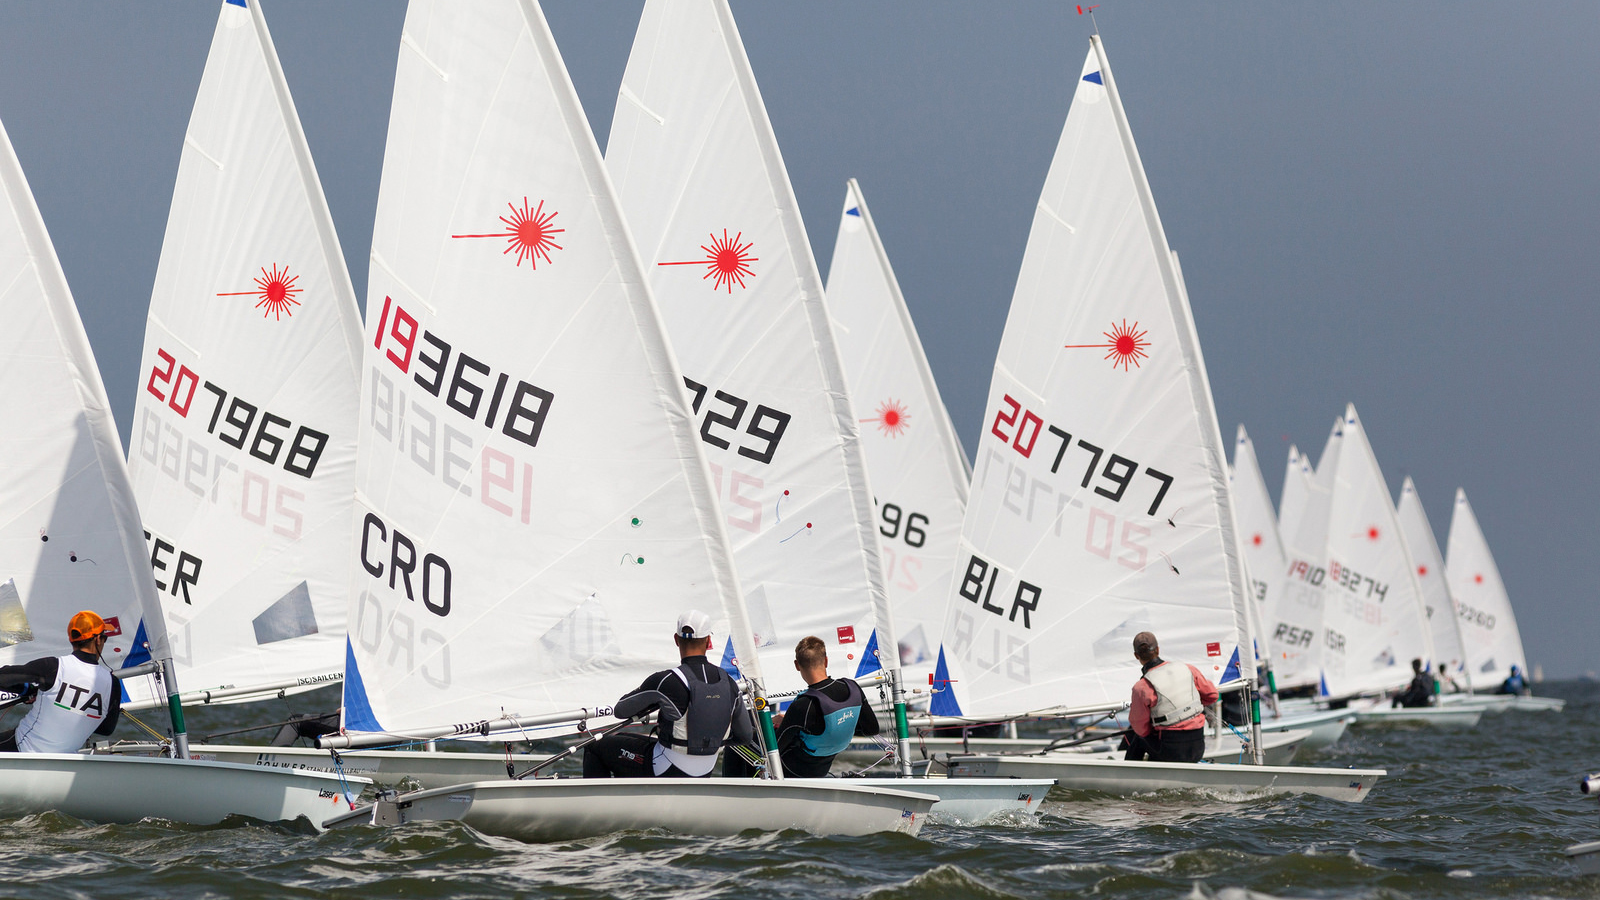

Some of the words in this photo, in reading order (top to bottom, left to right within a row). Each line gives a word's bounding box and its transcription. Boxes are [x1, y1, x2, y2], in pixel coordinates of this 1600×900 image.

[374, 295, 554, 448] 193618
[147, 348, 329, 479] 207968
[992, 393, 1174, 516] 207797
[874, 496, 929, 548] 96
[144, 530, 203, 605] ER
[360, 512, 452, 617] CRO
[959, 554, 1042, 629] BLR
[1273, 622, 1314, 649] RSA
[55, 682, 102, 715] ITA
[318, 788, 335, 799] Laser
